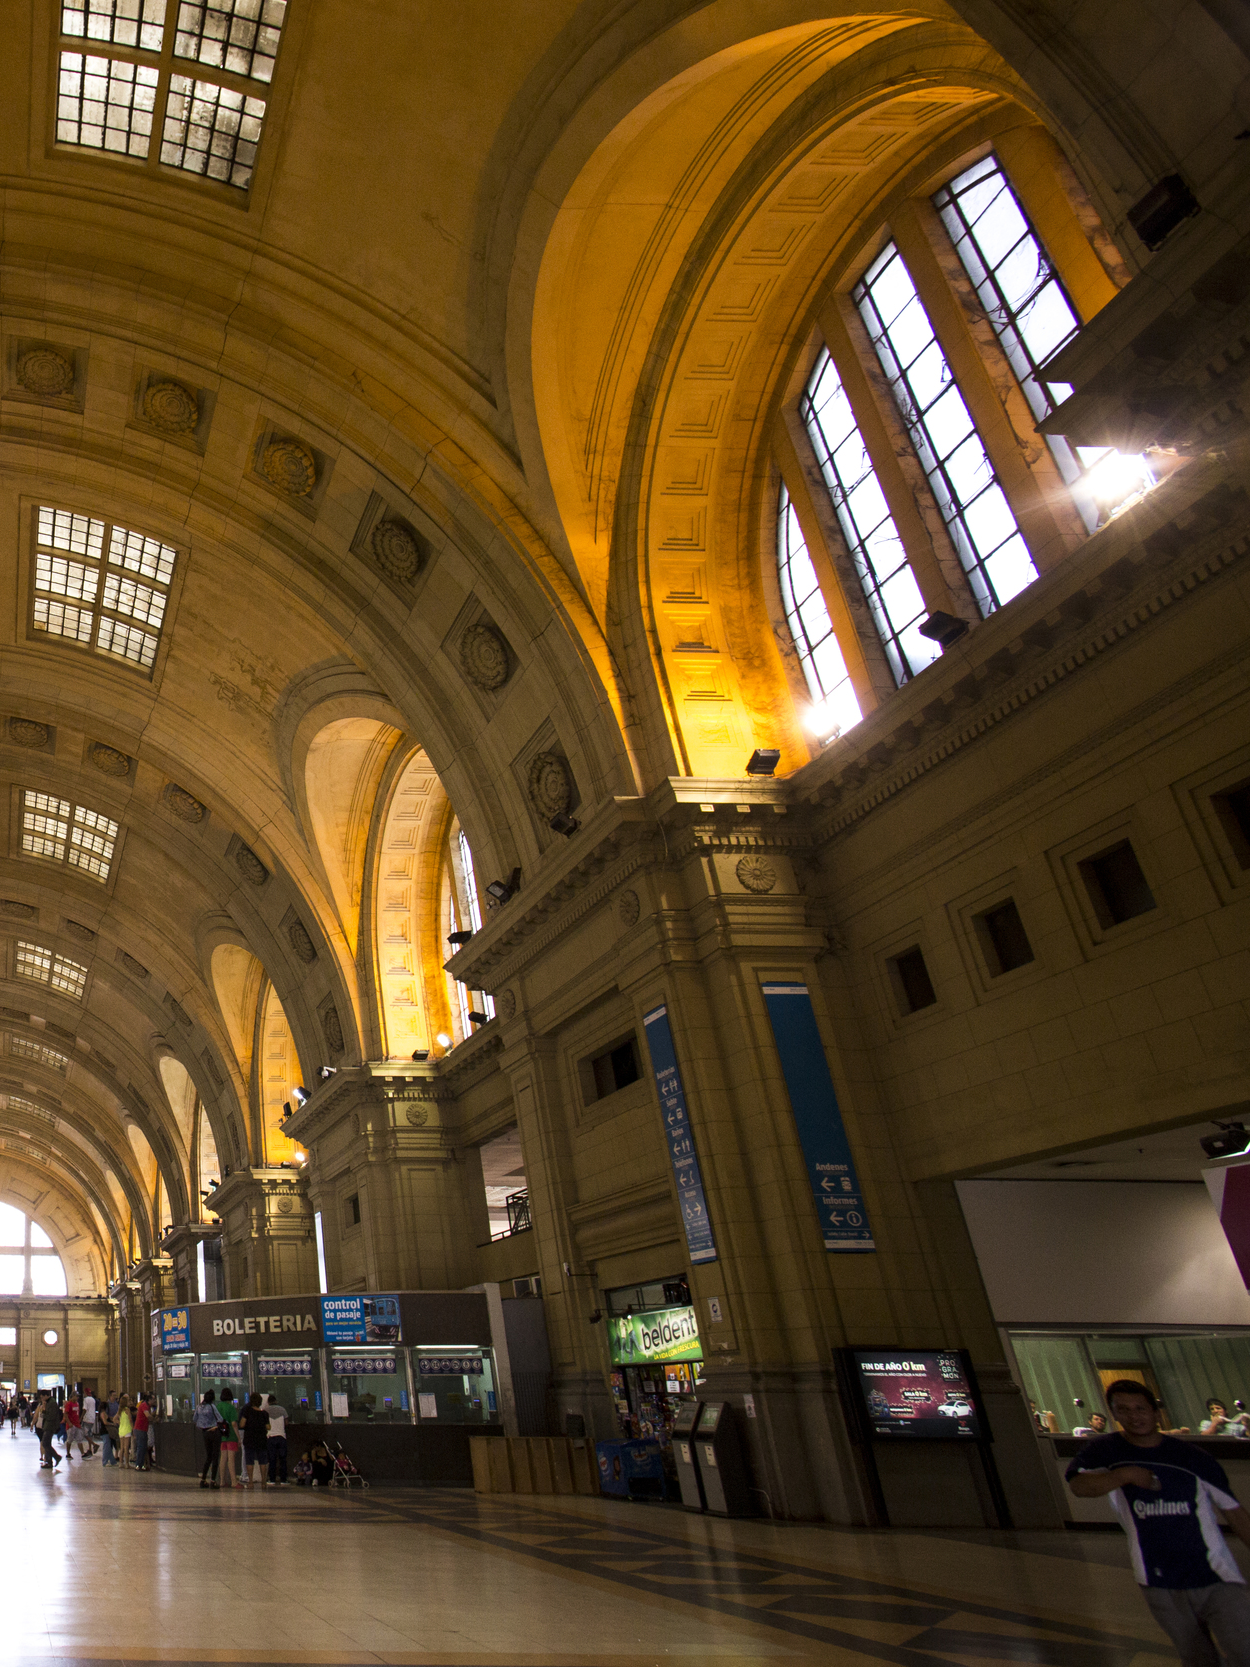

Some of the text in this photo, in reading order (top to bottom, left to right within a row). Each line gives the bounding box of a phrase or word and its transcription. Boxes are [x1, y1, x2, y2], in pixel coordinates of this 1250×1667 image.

[816, 1162, 849, 1171] Andenes
[822, 1196, 858, 1205] Informes
[324, 1298, 361, 1310] control
[325, 1309, 361, 1320] de pasaje
[212, 1314, 317, 1336] BOLETERIA
[641, 1309, 696, 1351] beldent
[677, 1341, 700, 1355] FRESCURA
[874, 1363, 885, 1371] DE
[885, 1362, 902, 1370] AÑO
[902, 1361, 911, 1371] 0
[911, 1361, 926, 1371] km
[1133, 1499, 1191, 1519] Quilmes
